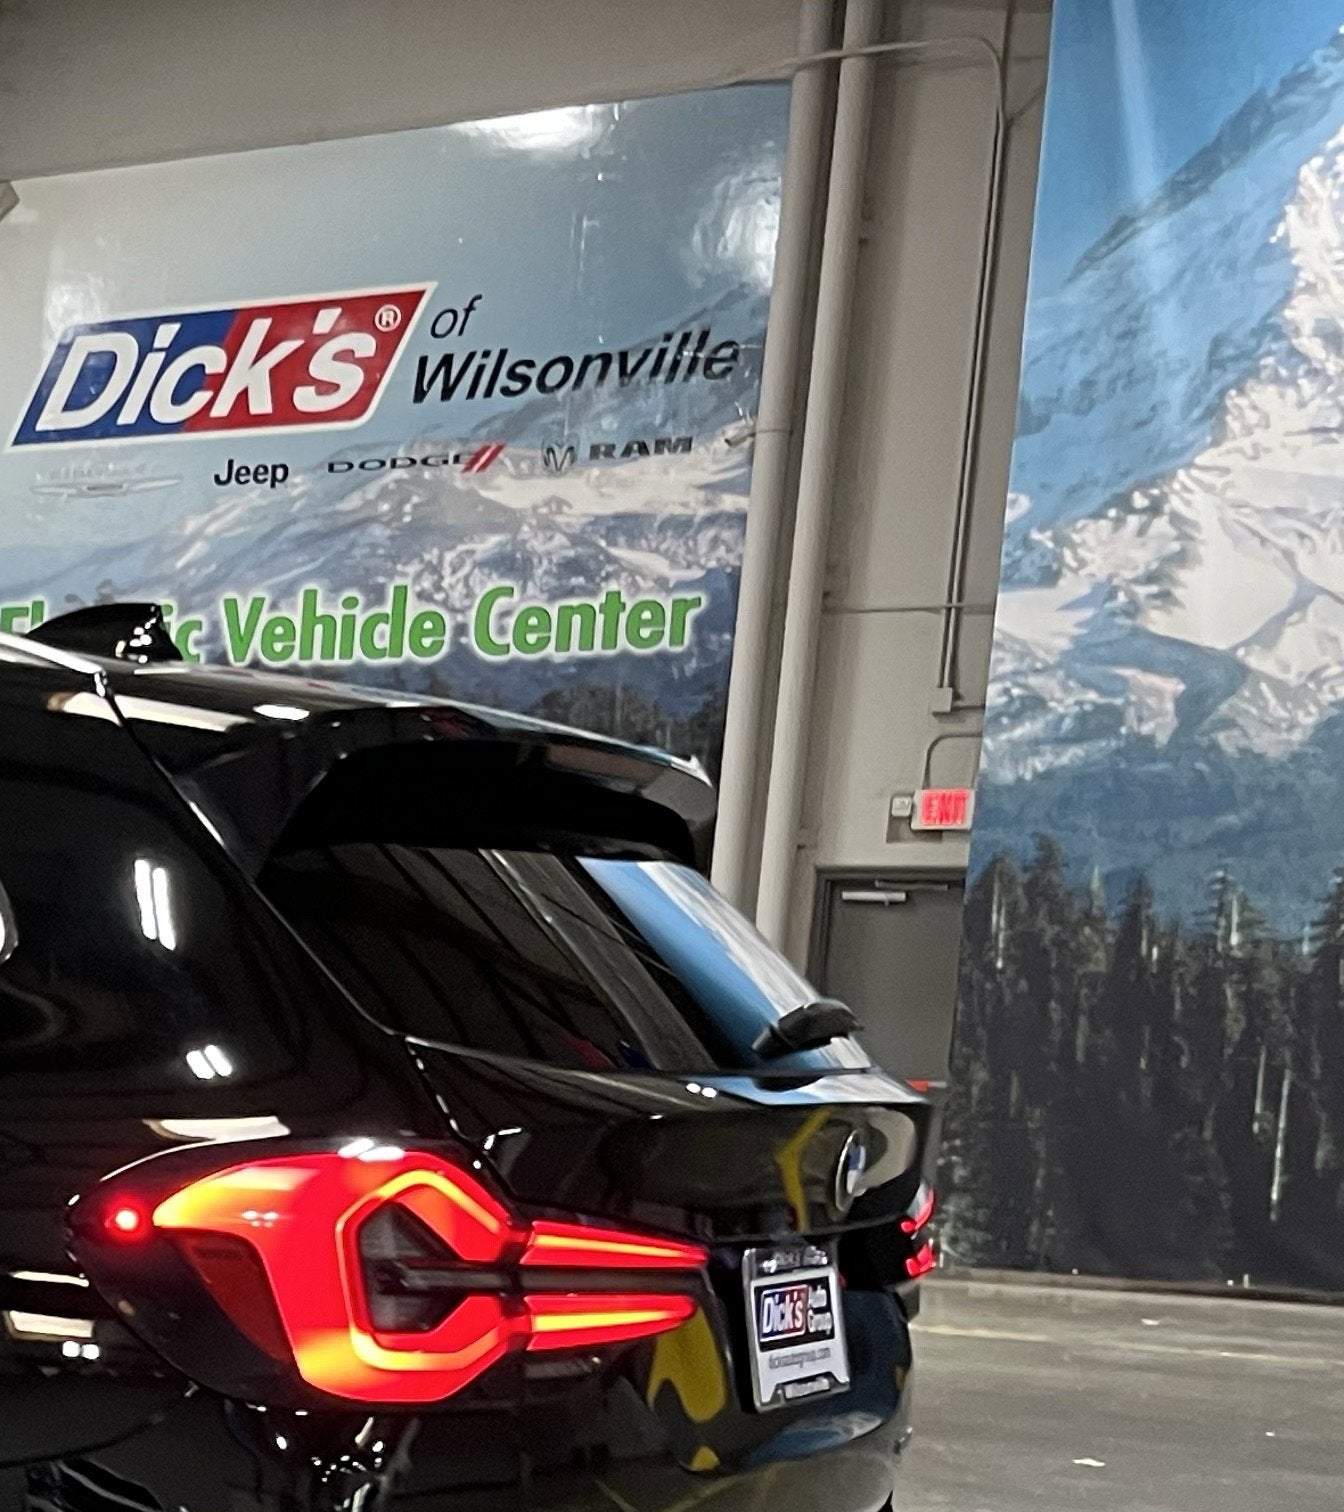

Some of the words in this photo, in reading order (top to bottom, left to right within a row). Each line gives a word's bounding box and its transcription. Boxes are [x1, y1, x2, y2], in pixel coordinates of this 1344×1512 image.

[430, 294, 483, 339] of
[34, 307, 377, 431] Dick's
[412, 328, 740, 404] Wilsonville
[214, 459, 289, 488] Jeep
[589, 436, 693, 461] RAM
[223, 585, 446, 662] Vehicle
[474, 586, 701, 656] Center
[762, 1291, 804, 1334] Dick's
